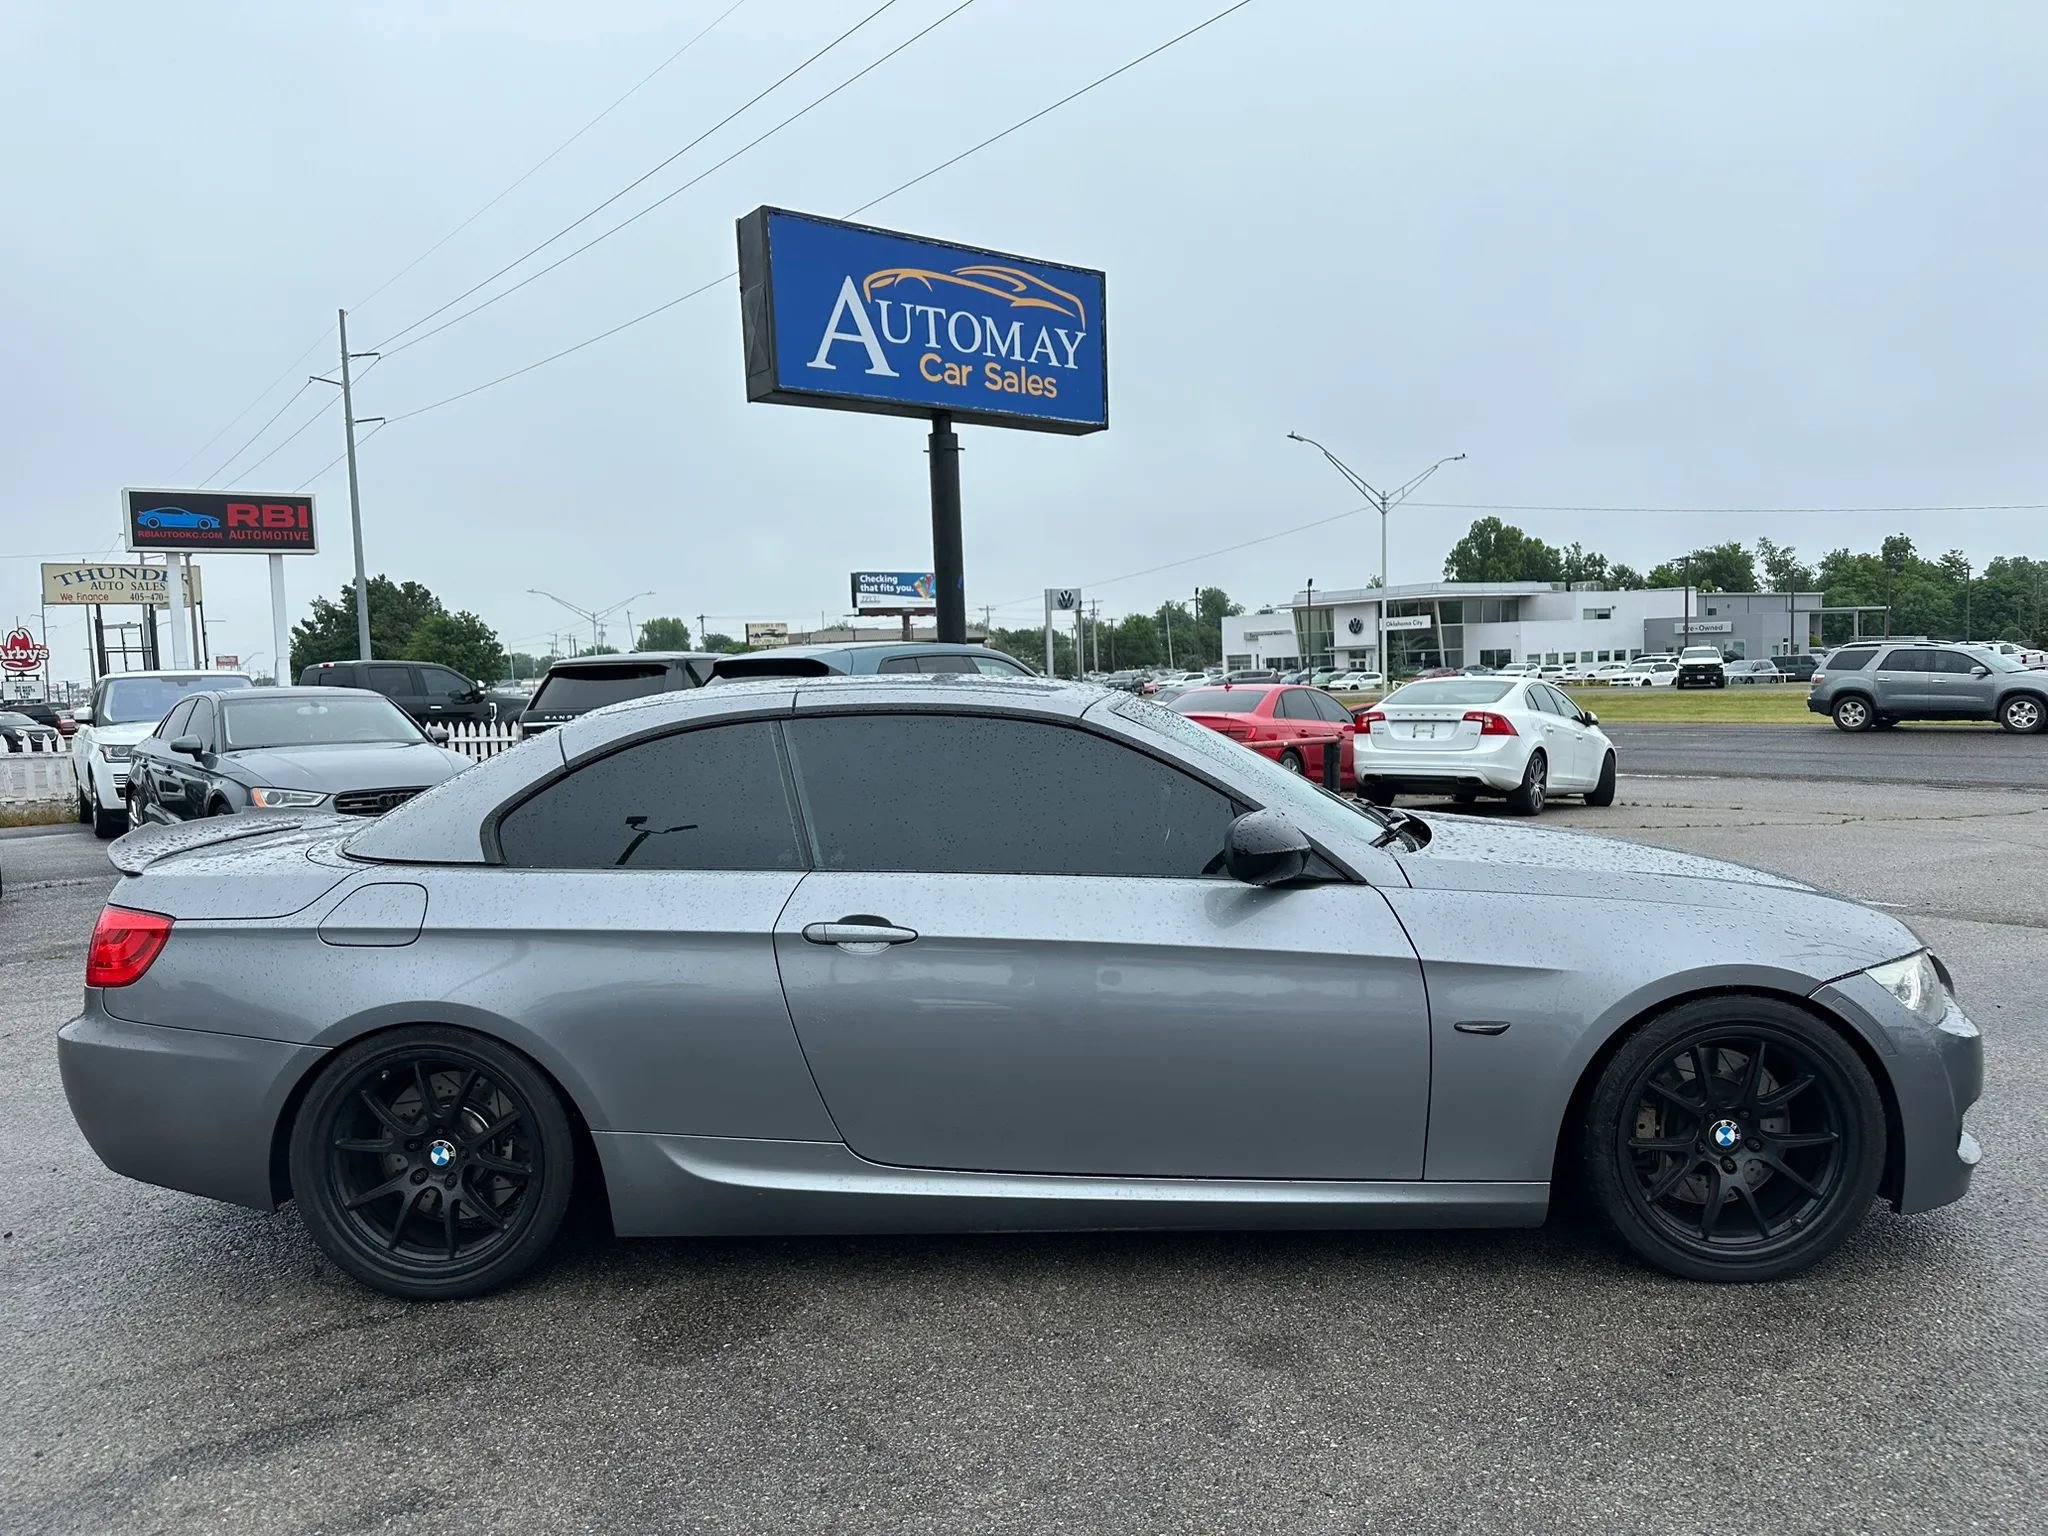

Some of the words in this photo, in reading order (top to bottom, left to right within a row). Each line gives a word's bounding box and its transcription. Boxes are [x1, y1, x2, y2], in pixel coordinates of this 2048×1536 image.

[806, 275, 1086, 377] AUTOMAY
[919, 353, 973, 387] Car
[984, 363, 1057, 399] Sales
[227, 503, 308, 529] RBI
[138, 529, 223, 540] RBIAUTOOKC.COM
[229, 530, 310, 541] AUTOMOTIVE
[860, 574, 898, 585] Checking
[90, 581, 124, 591] AUTO
[131, 581, 166, 592] SALES
[860, 583, 879, 592] that
[880, 583, 895, 592] fits
[895, 584, 914, 593] you.
[60, 592, 73, 601] We
[77, 592, 109, 601] Finance
[130, 592, 188, 602] 405-470-7
